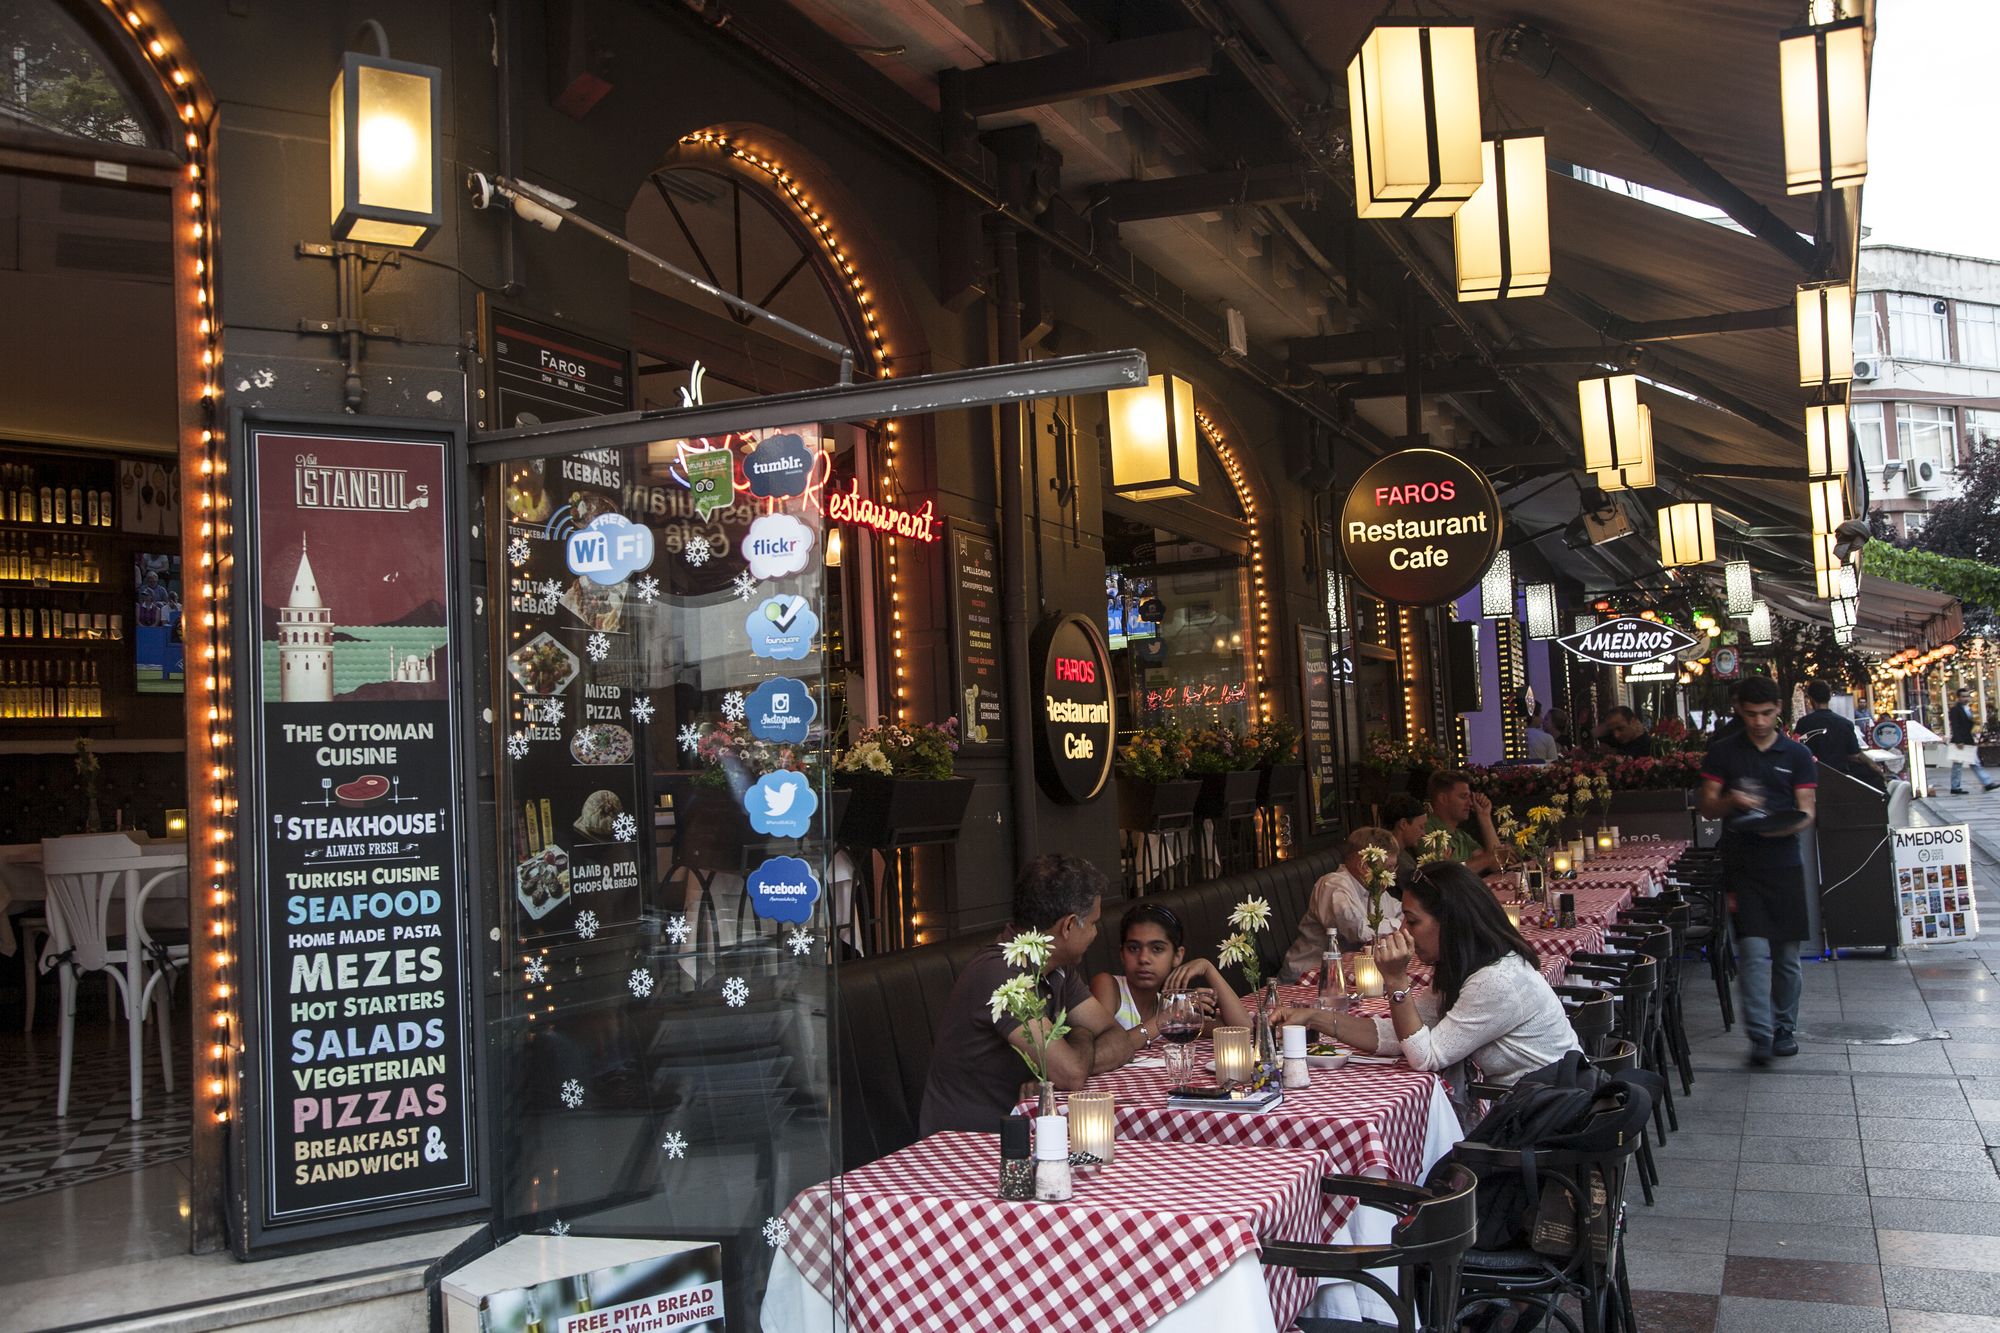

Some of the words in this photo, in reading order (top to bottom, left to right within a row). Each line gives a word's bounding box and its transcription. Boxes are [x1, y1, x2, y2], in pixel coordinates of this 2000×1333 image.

[540, 350, 586, 378] FAROS
[562, 460, 621, 489] KEBABS
[295, 468, 409, 510] ISTANBUL
[803, 449, 934, 543] Restaurant
[1375, 480, 1456, 507] FAROS
[528, 529, 547, 541] KEBA
[591, 515, 628, 531] FREE
[1348, 511, 1488, 544] Restaurant
[753, 538, 798, 556] flickr
[1389, 545, 1449, 571] Cafe
[511, 596, 556, 616] KEBAB
[1617, 623, 1637, 631] Cafe
[1579, 630, 1674, 652] AMEDROS
[1603, 650, 1652, 659] Restaurant
[1055, 657, 1096, 684] FAROS
[585, 684, 621, 699] MIXED
[524, 707, 559, 723] MIX
[586, 704, 622, 720] PIZZA
[1046, 695, 1110, 724] Restaurant
[283, 723, 323, 743] THE
[328, 723, 434, 742] OTTOMAN
[525, 727, 562, 741] MEZES
[1064, 732, 1094, 760] Cafe
[316, 747, 397, 767] CUISINE
[287, 813, 437, 841] STEAKHOUSE
[1896, 829, 1963, 848] AMEDROS
[325, 842, 365, 858] ALWAYS
[368, 841, 399, 855] FRESH
[286, 869, 367, 890] TURKISH
[371, 866, 440, 885] CUISINE
[572, 864, 601, 879] LAMB
[602, 865, 614, 891] &
[613, 861, 637, 876] PITA
[573, 881, 602, 894] CHOPS
[614, 877, 638, 889] BREAD
[758, 881, 807, 895] facebook
[287, 889, 442, 925] SEAFOOD
[288, 932, 335, 949] HOME
[339, 928, 386, 945] MADE
[393, 924, 442, 940] PASTA
[289, 946, 443, 994] MEZES
[291, 1001, 338, 1022] HOT
[343, 990, 445, 1018] STARTERS
[291, 1018, 446, 1064] SALADS
[292, 1054, 446, 1091] VEGETERIAN
[293, 1083, 447, 1134] PIZZAS
[295, 1126, 420, 1162] BREAKFAST
[295, 1150, 419, 1186] SANDWICH
[424, 1125, 448, 1163] &
[568, 1313, 608, 1333] FREE
[614, 1303, 652, 1325] PITA
[657, 1288, 713, 1313] BREAD
[626, 1317, 662, 1333] WITH
[667, 1305, 715, 1327] DINNER
